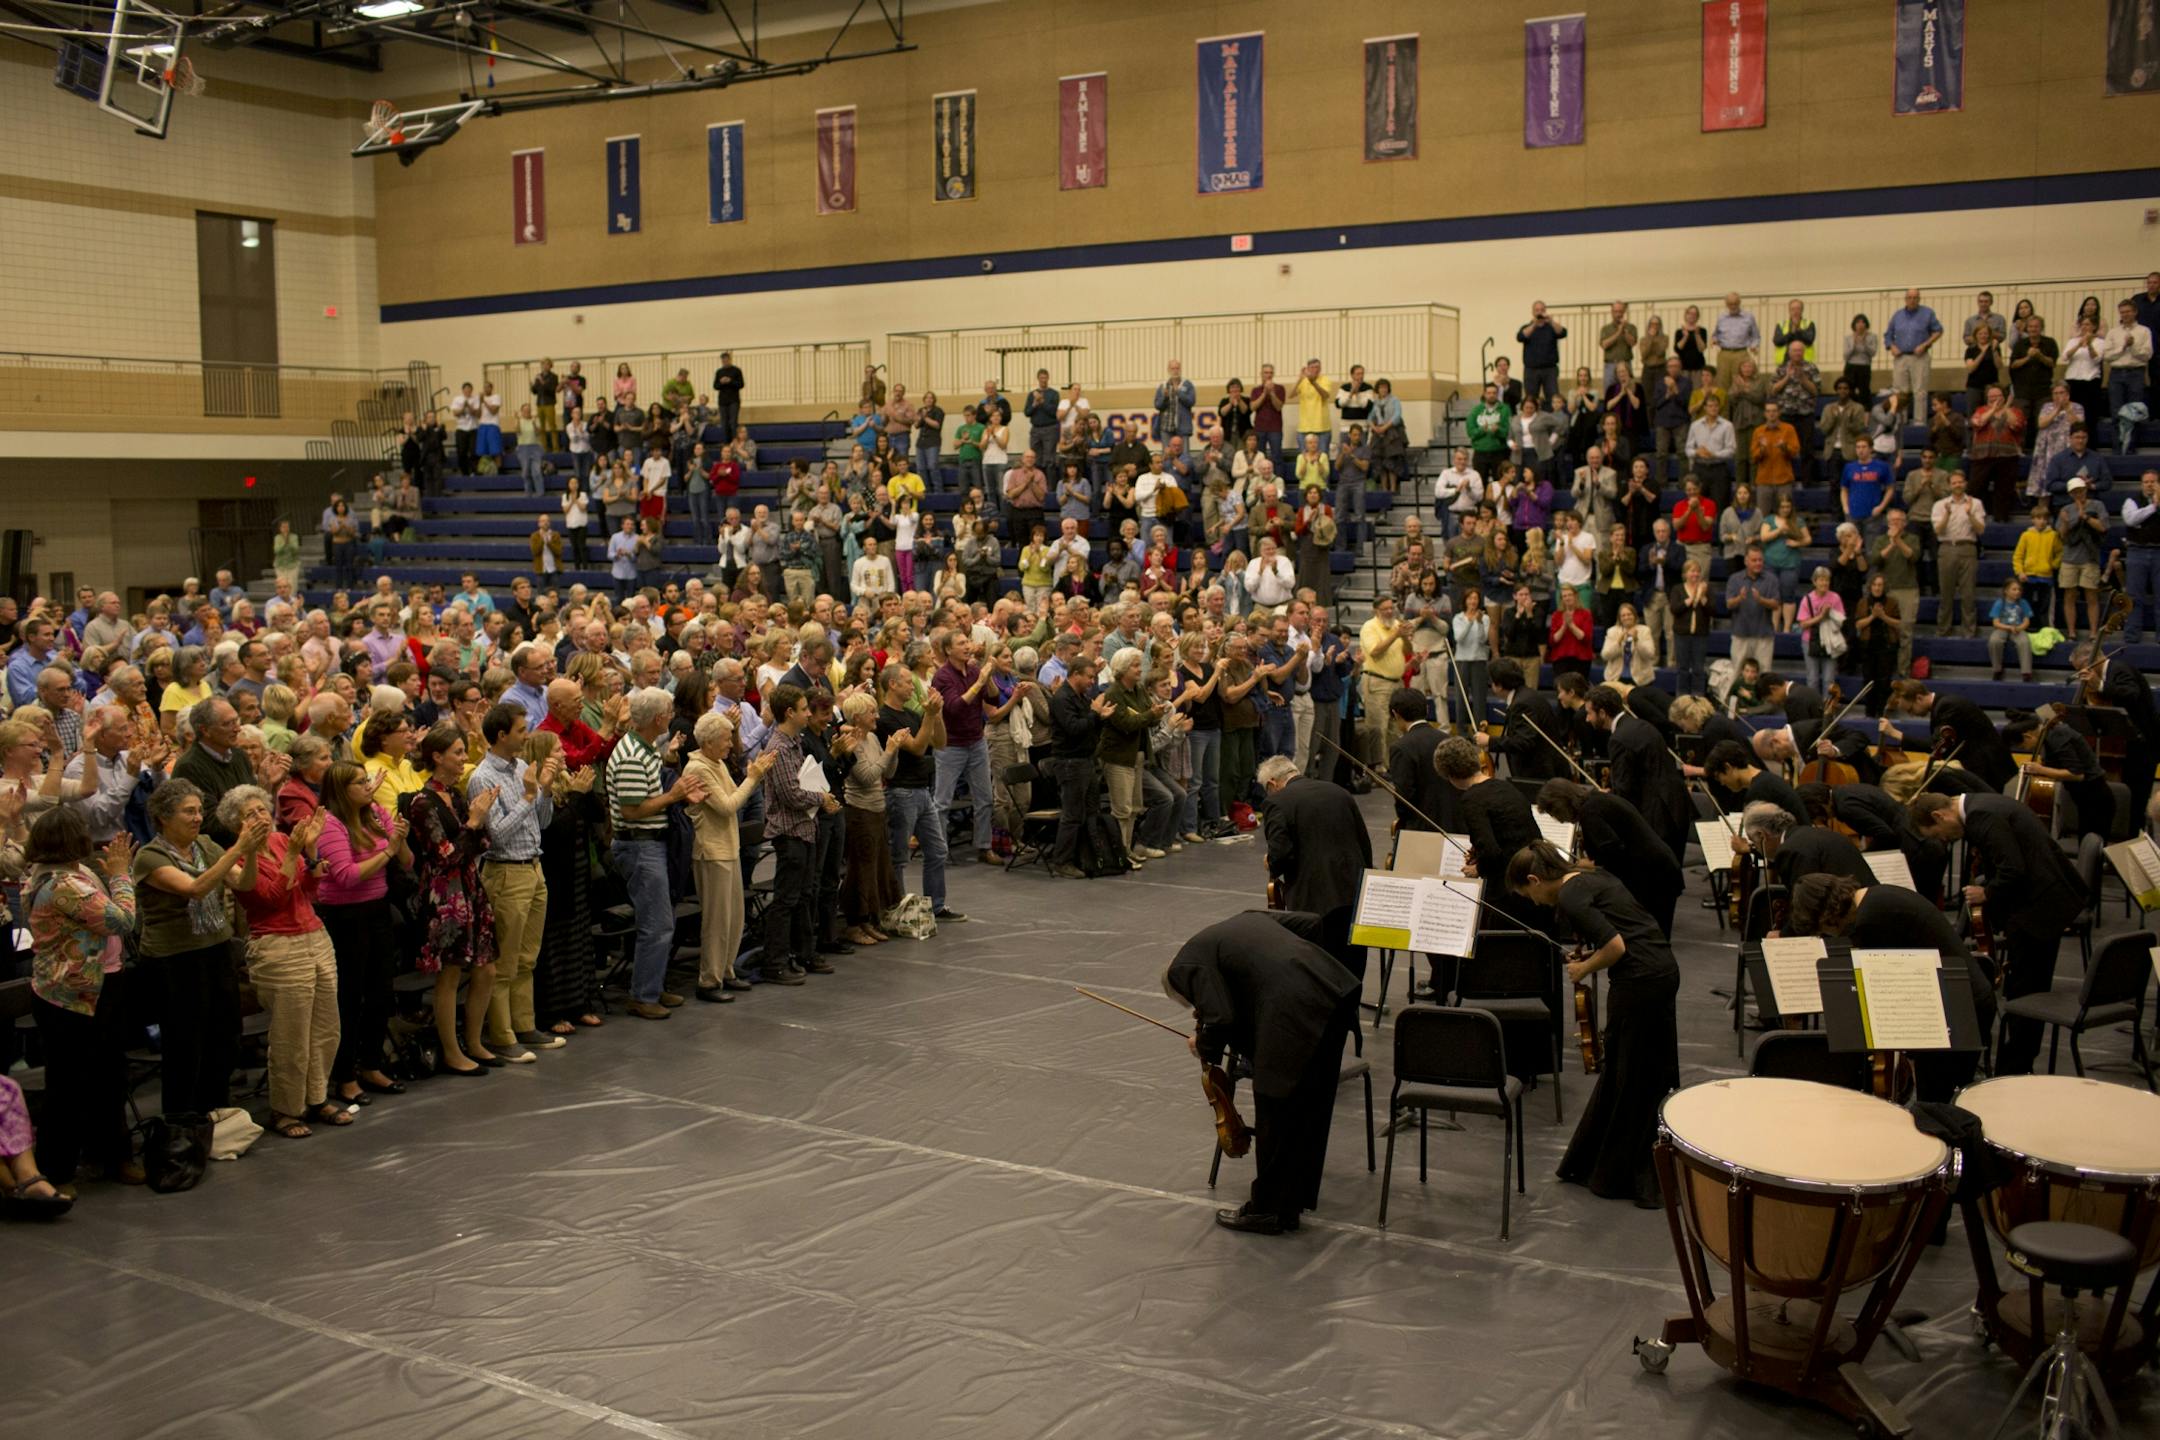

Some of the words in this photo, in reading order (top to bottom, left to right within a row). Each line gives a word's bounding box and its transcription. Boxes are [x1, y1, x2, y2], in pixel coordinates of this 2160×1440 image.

[1729, 32, 1741, 94] JOHNS
[1923, 8, 1938, 68] MARYS
[1077, 81, 1089, 153] HAMLINE
[1221, 42, 1239, 168] MACALESTER
[1107, 412, 1217, 443] SCS
